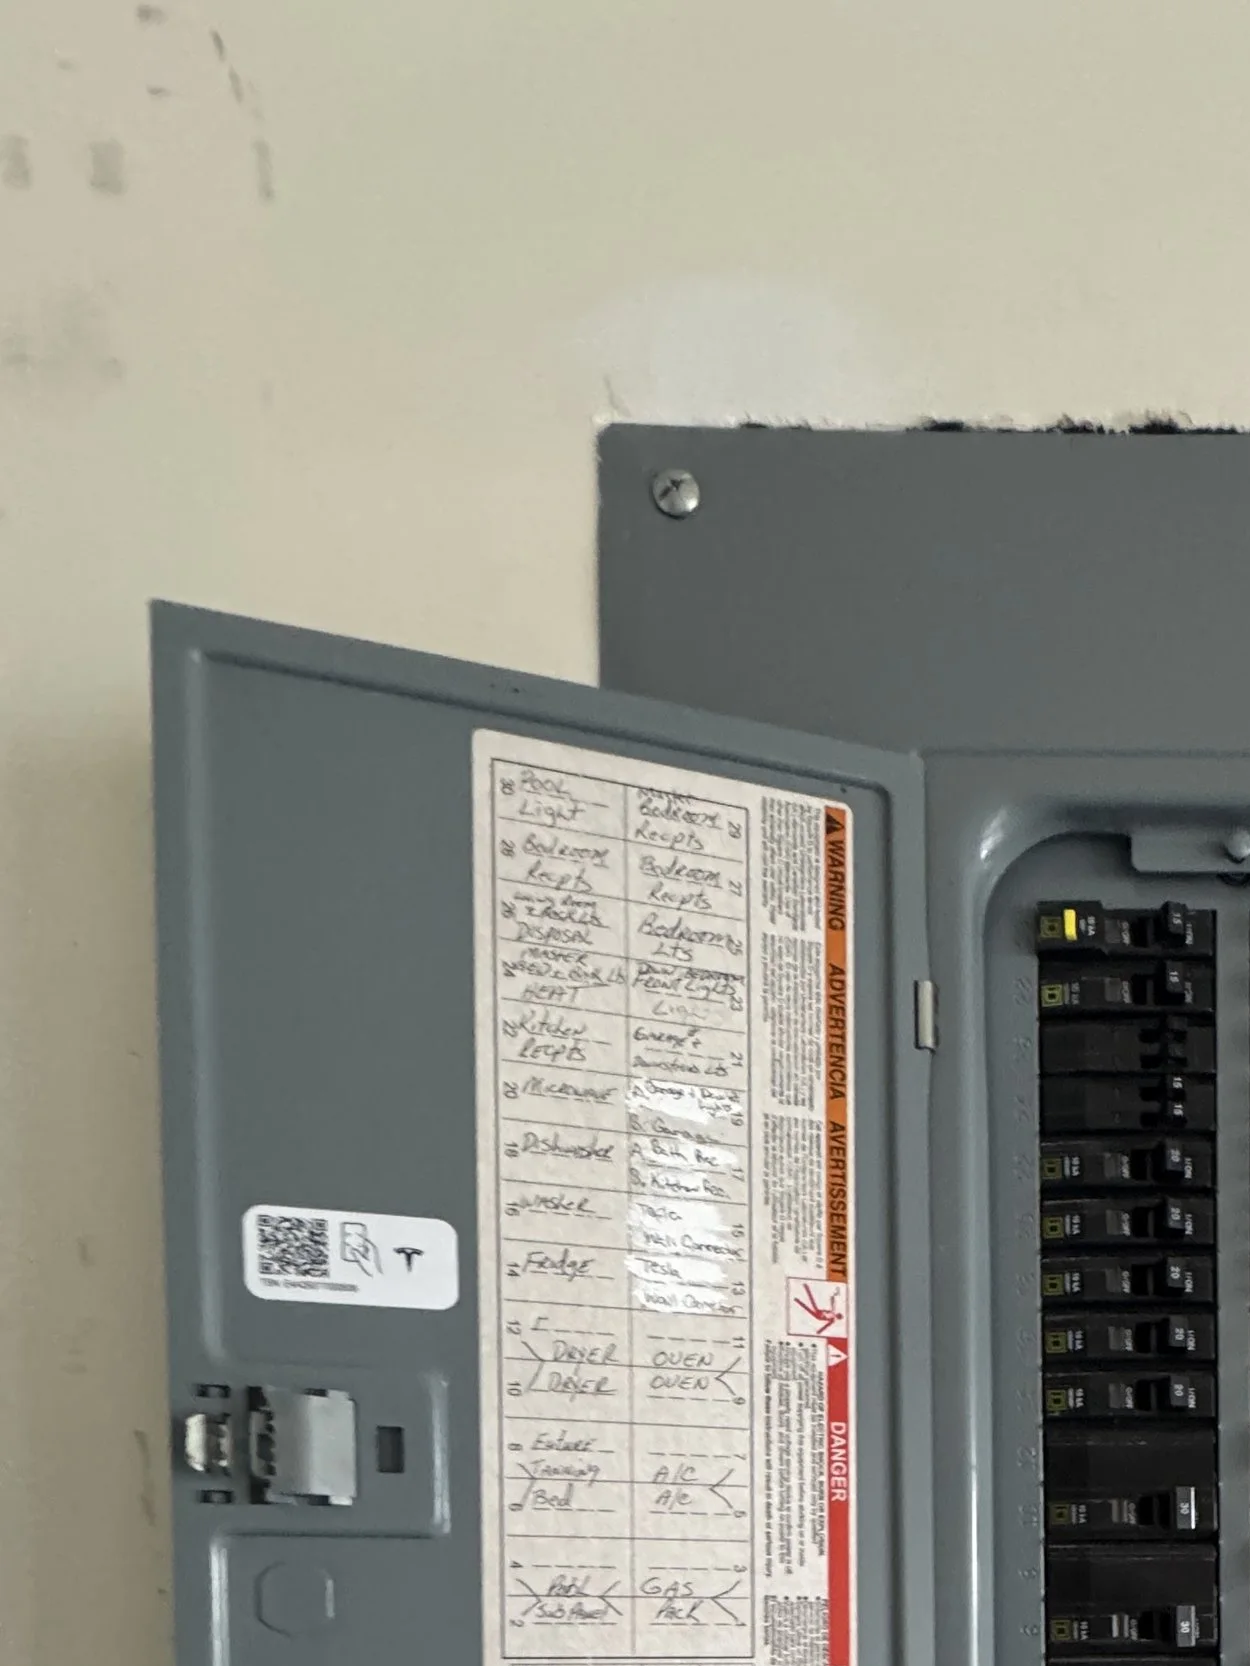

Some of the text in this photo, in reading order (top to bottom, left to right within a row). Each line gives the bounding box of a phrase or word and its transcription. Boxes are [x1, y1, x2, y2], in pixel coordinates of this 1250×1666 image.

[828, 839, 846, 931] WARNING
[1172, 912, 1181, 924] 15
[829, 962, 847, 1101] ADVERTENCIA
[1173, 1077, 1183, 1088] 15
[1171, 1148, 1180, 1162] 20
[829, 1119, 848, 1282] AVERTISSEMENT
[1171, 1207, 1180, 1220] 20
[1171, 1266, 1180, 1279] 20
[1175, 1328, 1184, 1340] 20
[652, 1351, 715, 1368] OVEN
[650, 1375, 711, 1391] OVEN
[1174, 1384, 1183, 1396] 20
[830, 1421, 847, 1501] DANGER
[1180, 1502, 1190, 1514] 30
[639, 1576, 694, 1598] GAS
[1180, 1621, 1190, 1633] 30
